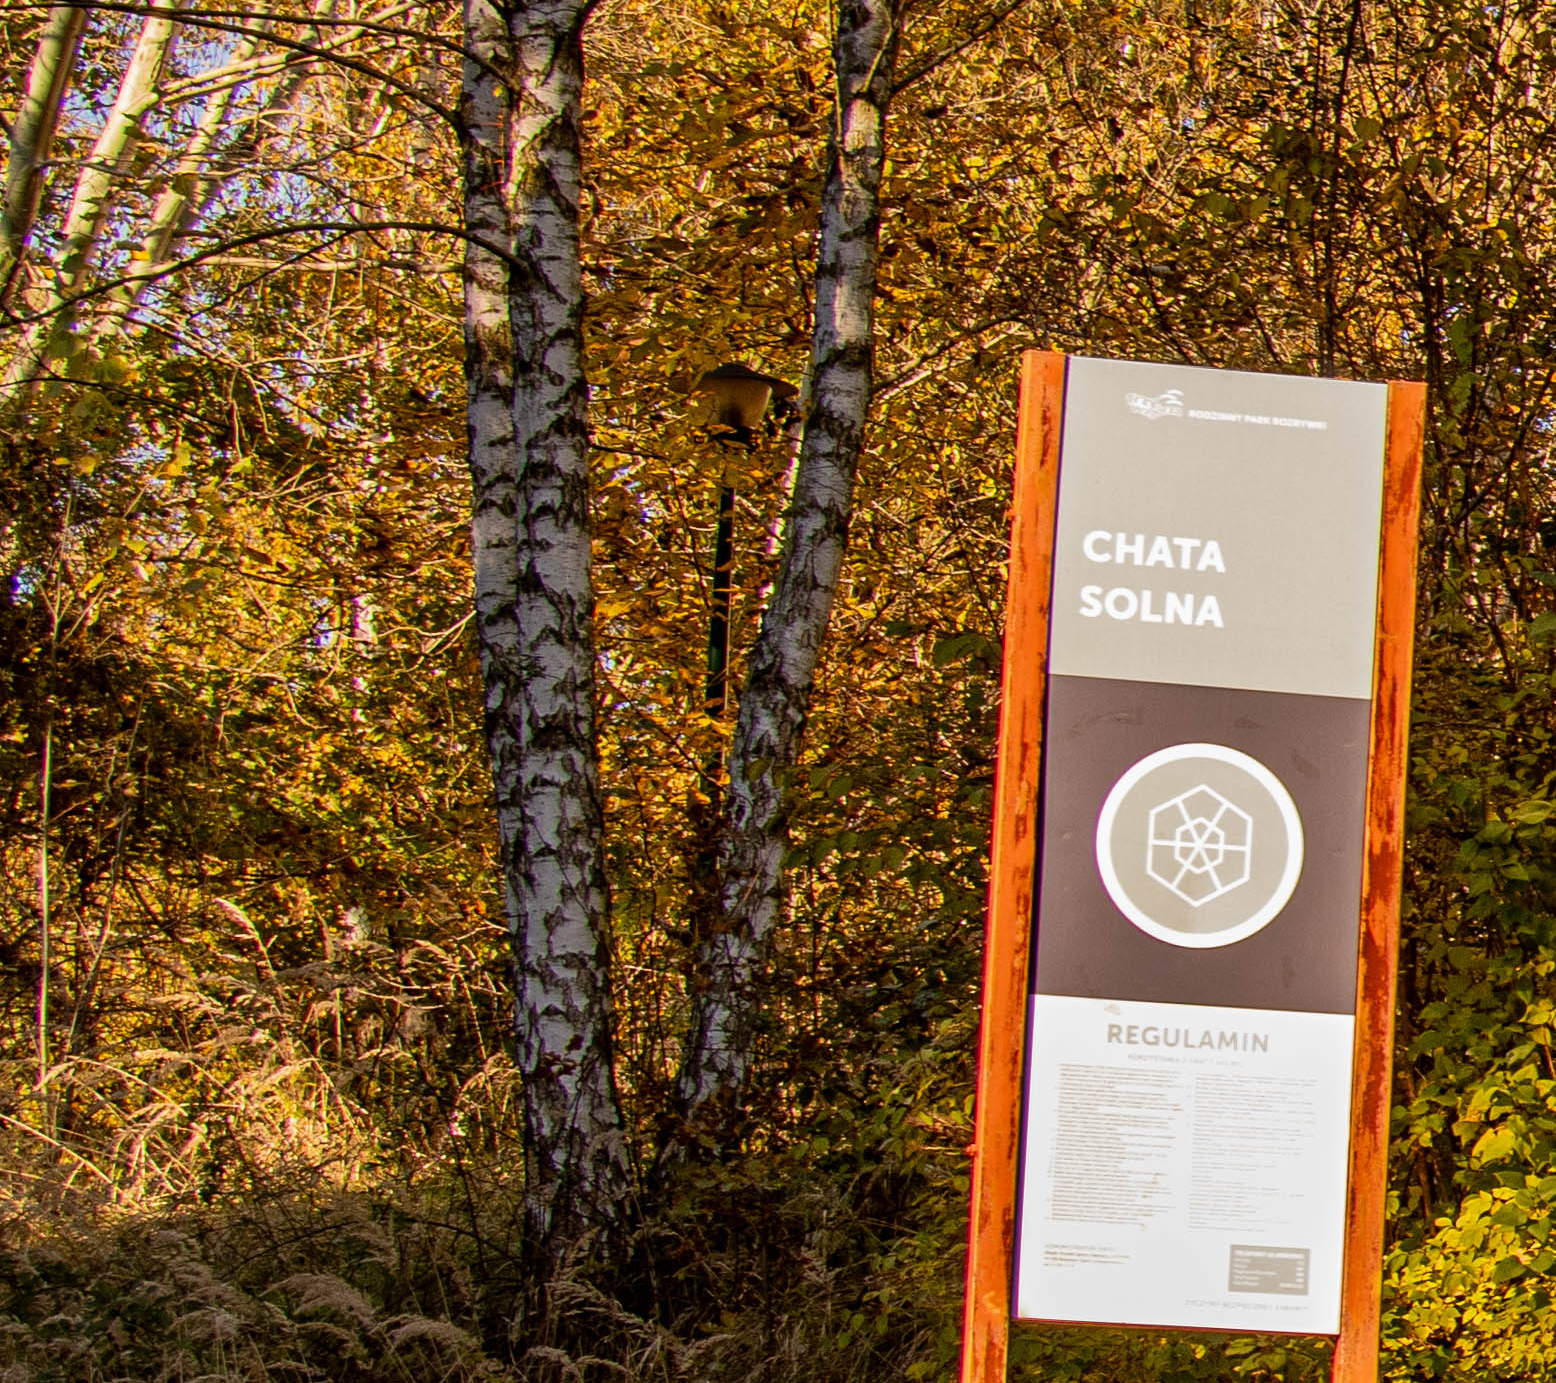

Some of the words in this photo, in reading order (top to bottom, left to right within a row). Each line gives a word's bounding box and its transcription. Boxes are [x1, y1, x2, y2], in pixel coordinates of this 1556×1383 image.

[1083, 530, 1226, 574] CHATA
[1079, 585, 1224, 628] SOLNA
[1106, 1024, 1270, 1054] REGULAMIN
